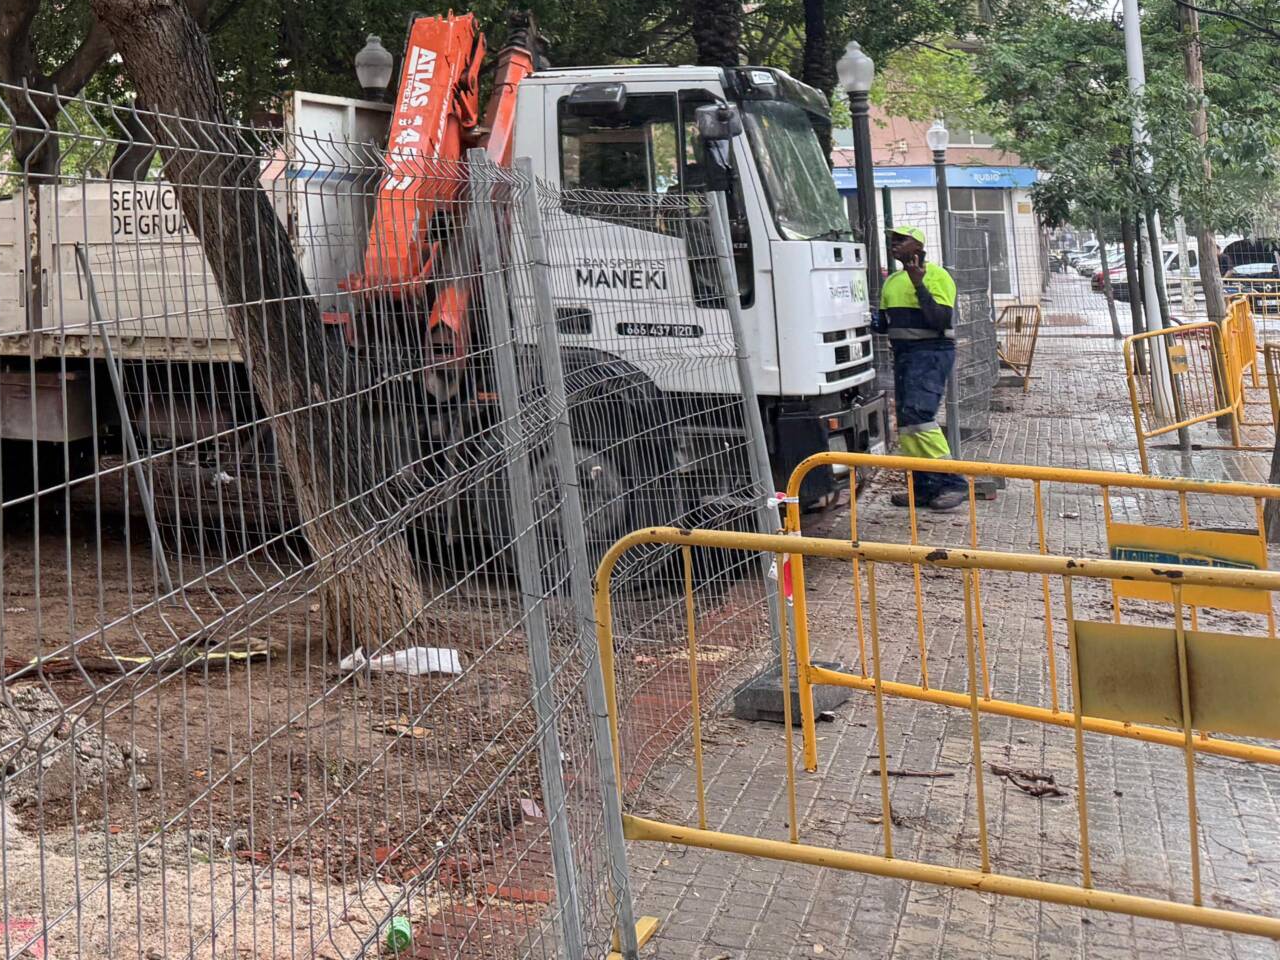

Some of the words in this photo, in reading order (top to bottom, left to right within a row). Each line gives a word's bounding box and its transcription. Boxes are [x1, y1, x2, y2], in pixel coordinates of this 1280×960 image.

[410, 47, 438, 108] ATLAS
[111, 189, 179, 211] SERVICI
[111, 215, 133, 235] DE
[575, 257, 666, 270] TRANSPORTES
[576, 269, 668, 290] MANEKI
[650, 325, 670, 337] 437
[674, 326, 692, 337] 120
